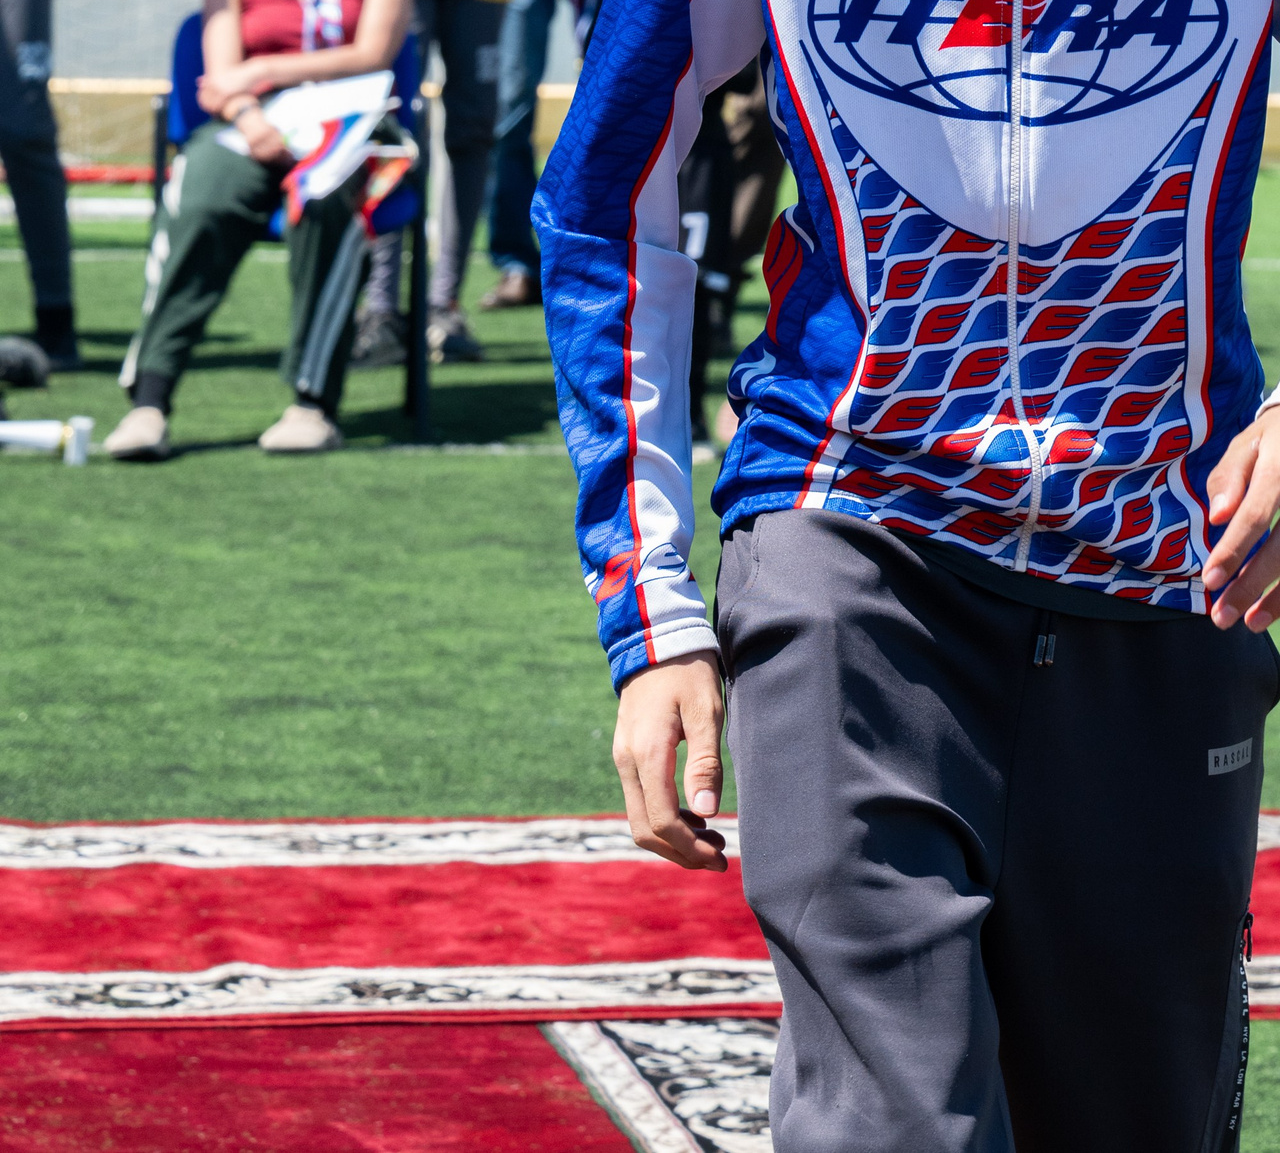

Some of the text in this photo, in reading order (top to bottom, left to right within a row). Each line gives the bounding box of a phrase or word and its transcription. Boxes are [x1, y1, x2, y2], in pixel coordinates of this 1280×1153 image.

[1214, 746, 1249, 768] RASCAL
[1241, 1050, 1247, 1062] LA
[1236, 1068, 1245, 1085] LDN
[1228, 1114, 1238, 1130] TKY
